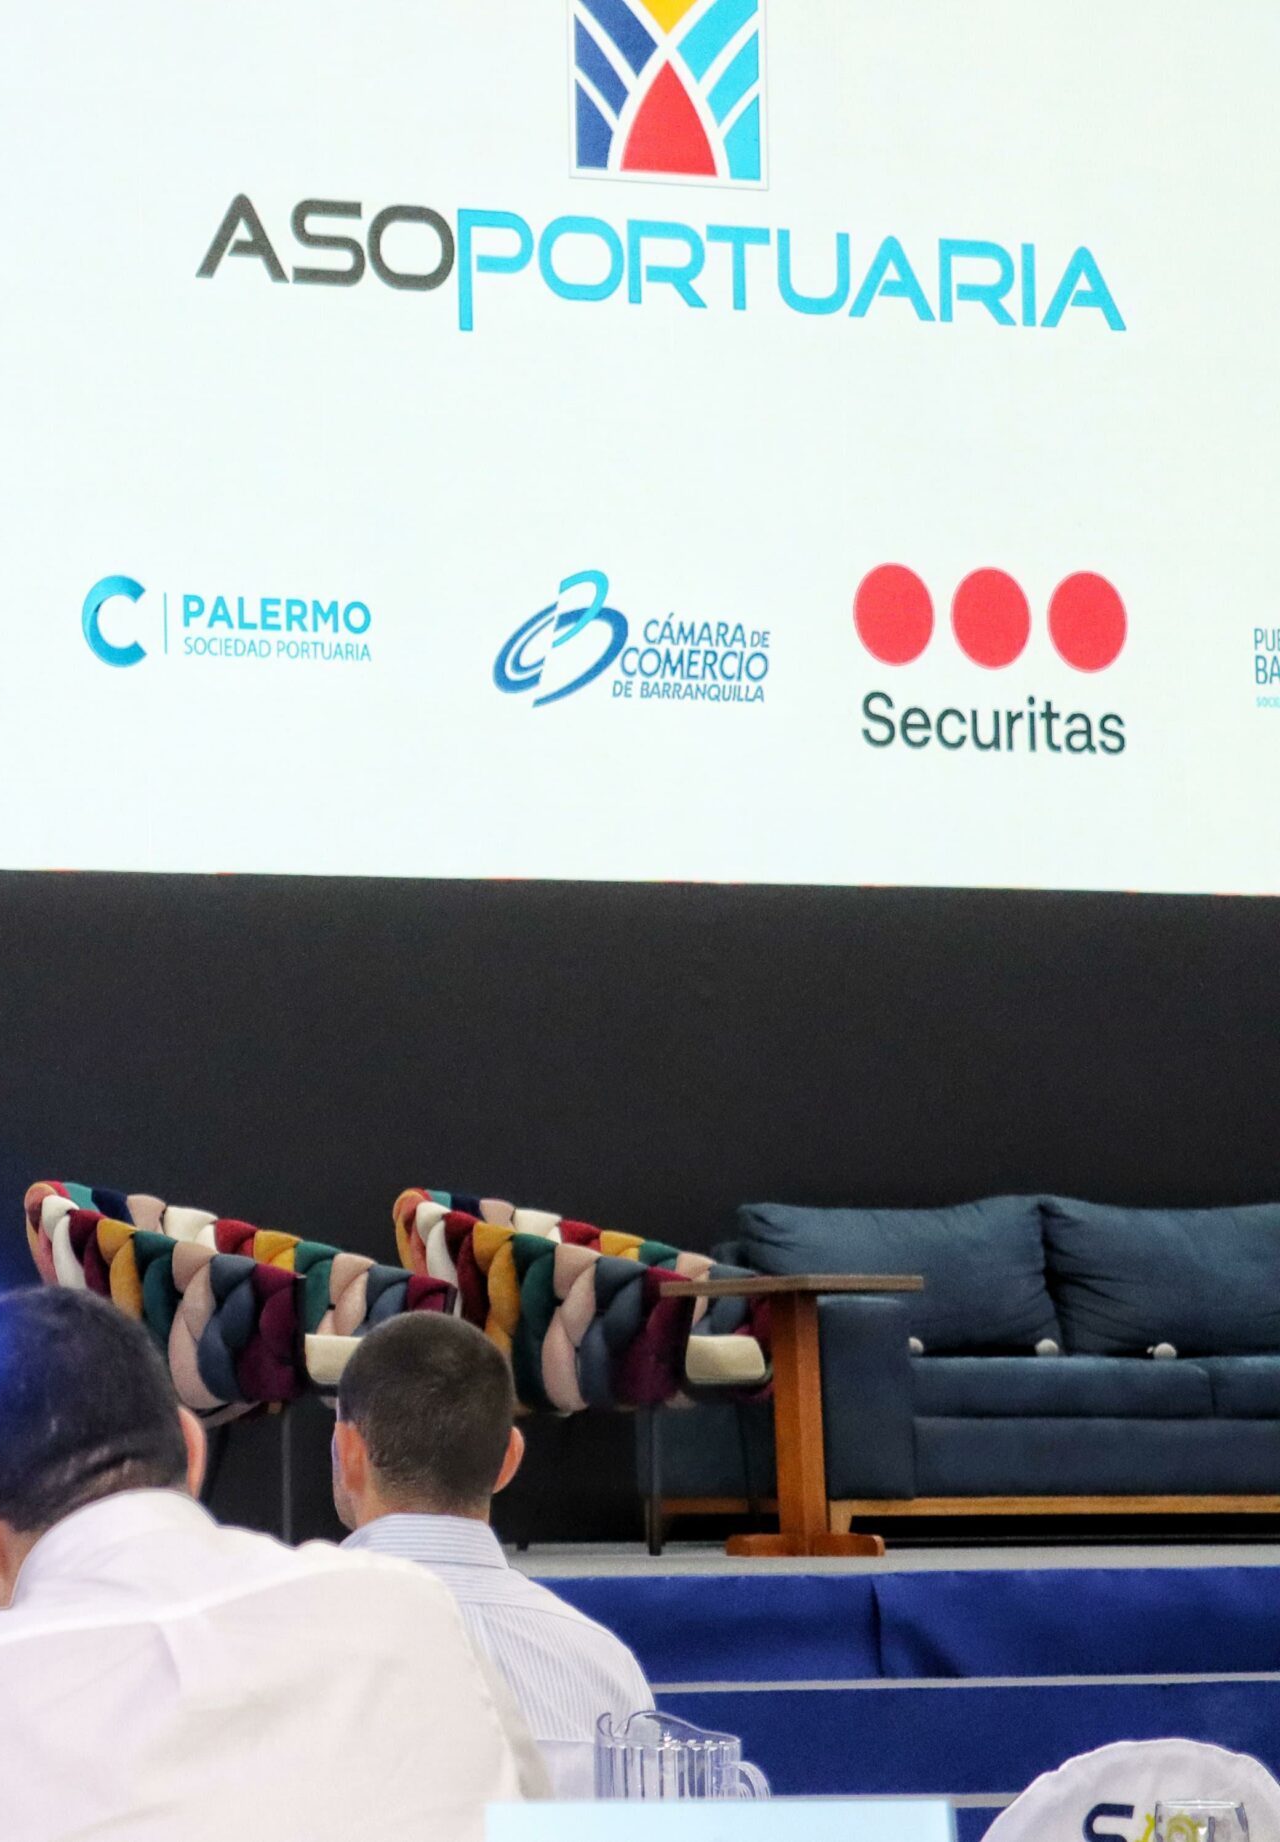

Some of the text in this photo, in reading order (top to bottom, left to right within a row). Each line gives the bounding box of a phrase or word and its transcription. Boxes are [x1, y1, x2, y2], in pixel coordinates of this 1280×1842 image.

[195, 193, 1127, 333] ASOPORTUARIA
[182, 593, 372, 636] PALERMO
[643, 612, 770, 649] CÁMARA DE
[183, 636, 371, 662] SOCIEDAD PORTUARIA
[620, 647, 770, 682] COMERCIO
[612, 680, 766, 704] DE BARRANQUILLA
[862, 690, 1126, 755] Securitas
